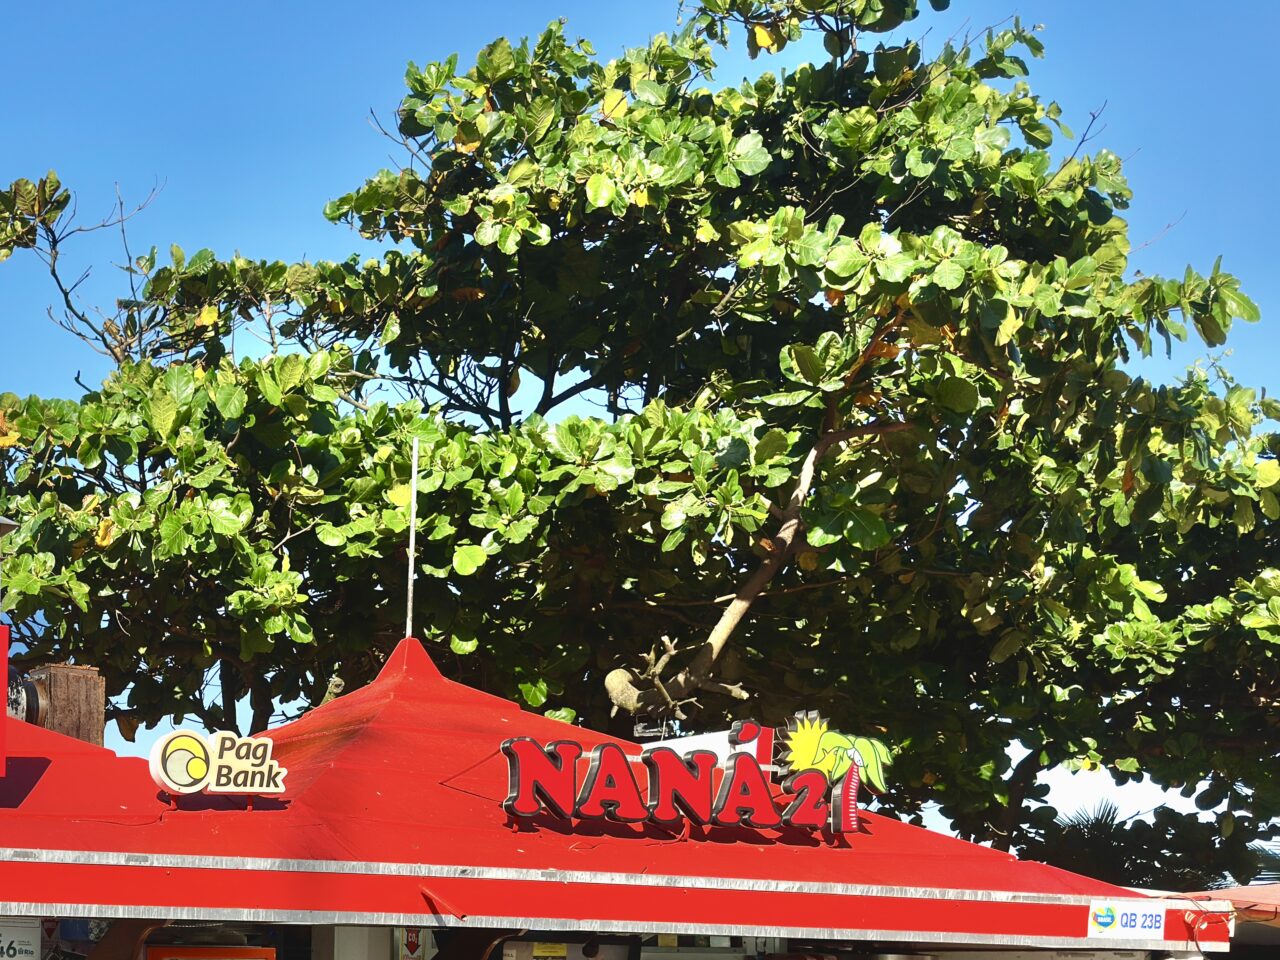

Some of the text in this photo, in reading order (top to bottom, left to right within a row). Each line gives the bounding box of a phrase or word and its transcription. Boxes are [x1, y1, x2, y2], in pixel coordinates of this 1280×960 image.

[218, 737, 268, 767] Pag
[215, 764, 281, 788] Bank
[1121, 913, 1162, 929] QB 23B
